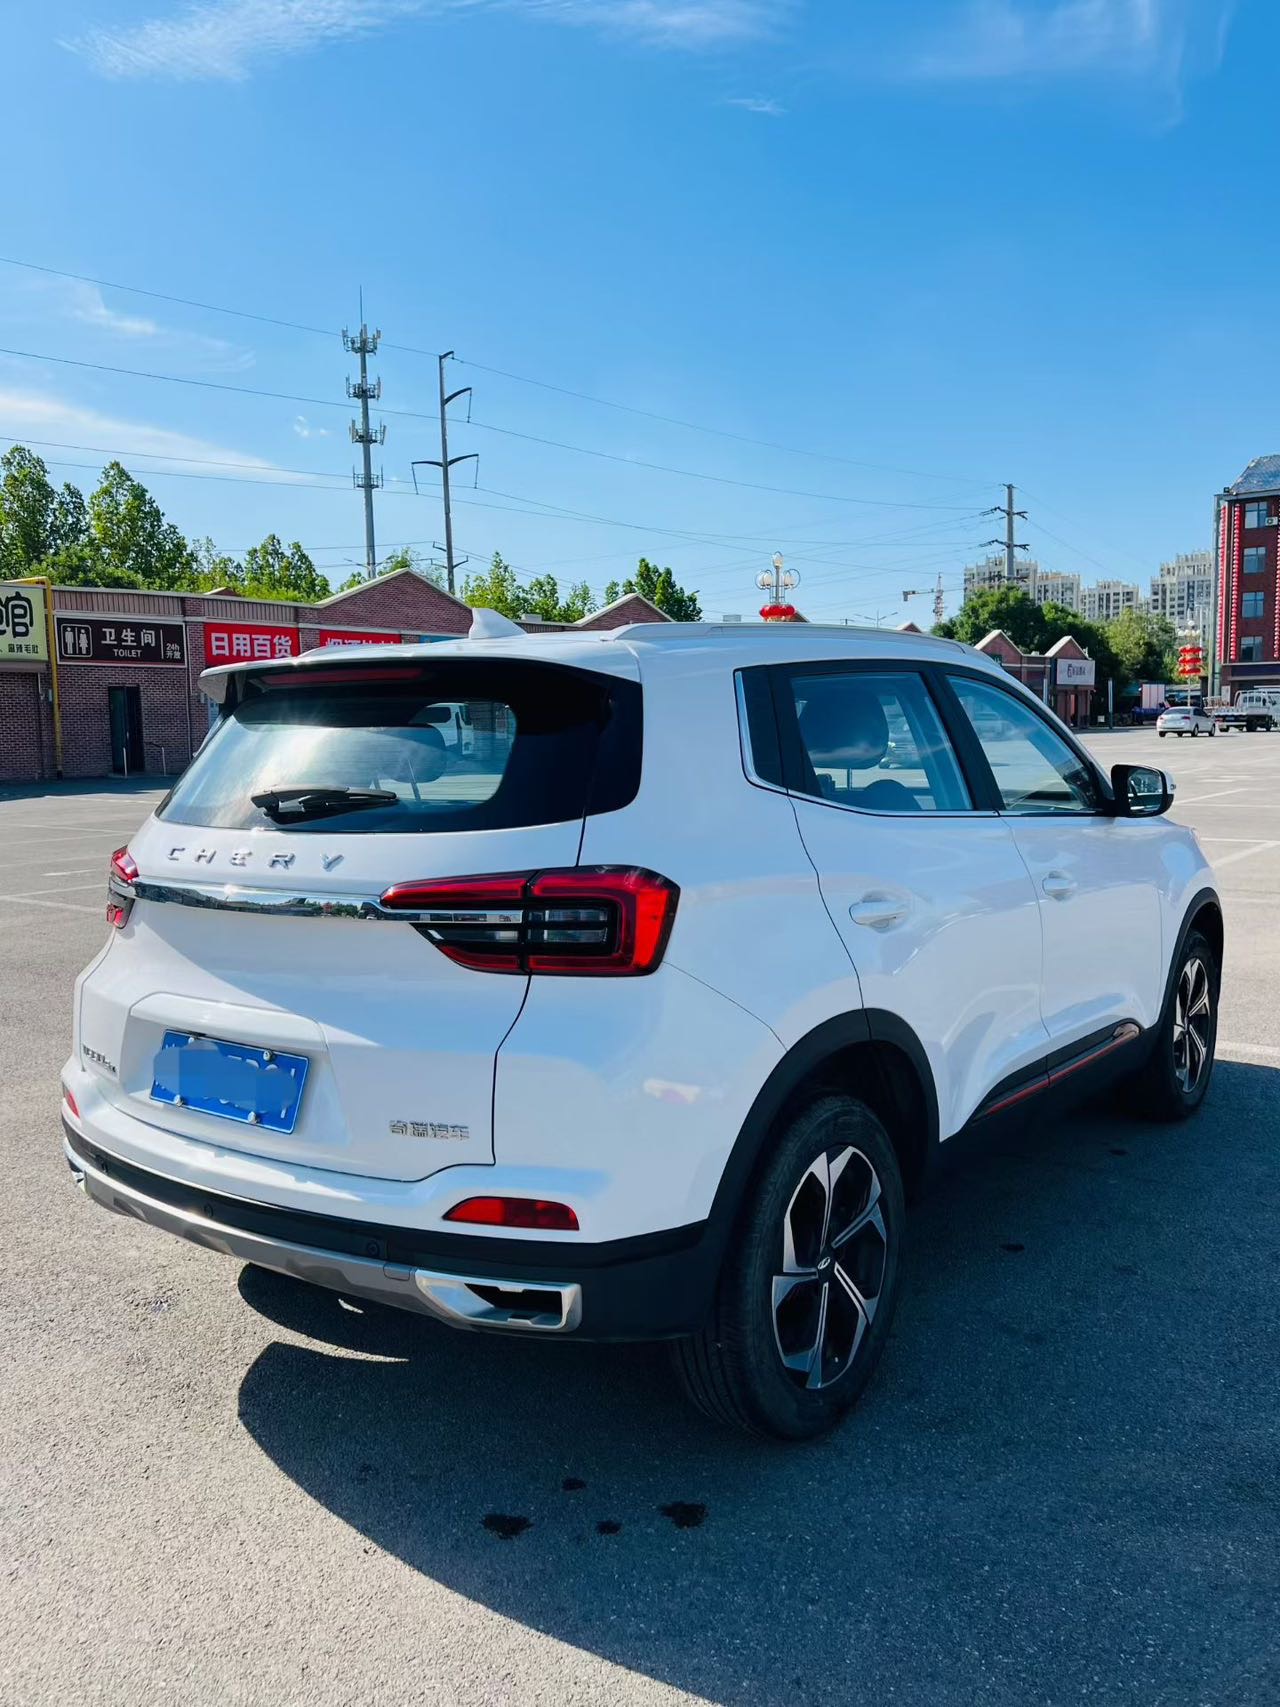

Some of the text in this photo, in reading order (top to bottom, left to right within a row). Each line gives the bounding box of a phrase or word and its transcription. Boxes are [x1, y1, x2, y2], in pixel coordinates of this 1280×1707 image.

[101, 628, 155, 647] 卫生间
[166, 643, 180, 651] 24h
[211, 633, 292, 658] 日用百货
[113, 649, 142, 657] TOILET
[166, 651, 181, 659] 开放
[168, 847, 344, 872] CHERY
